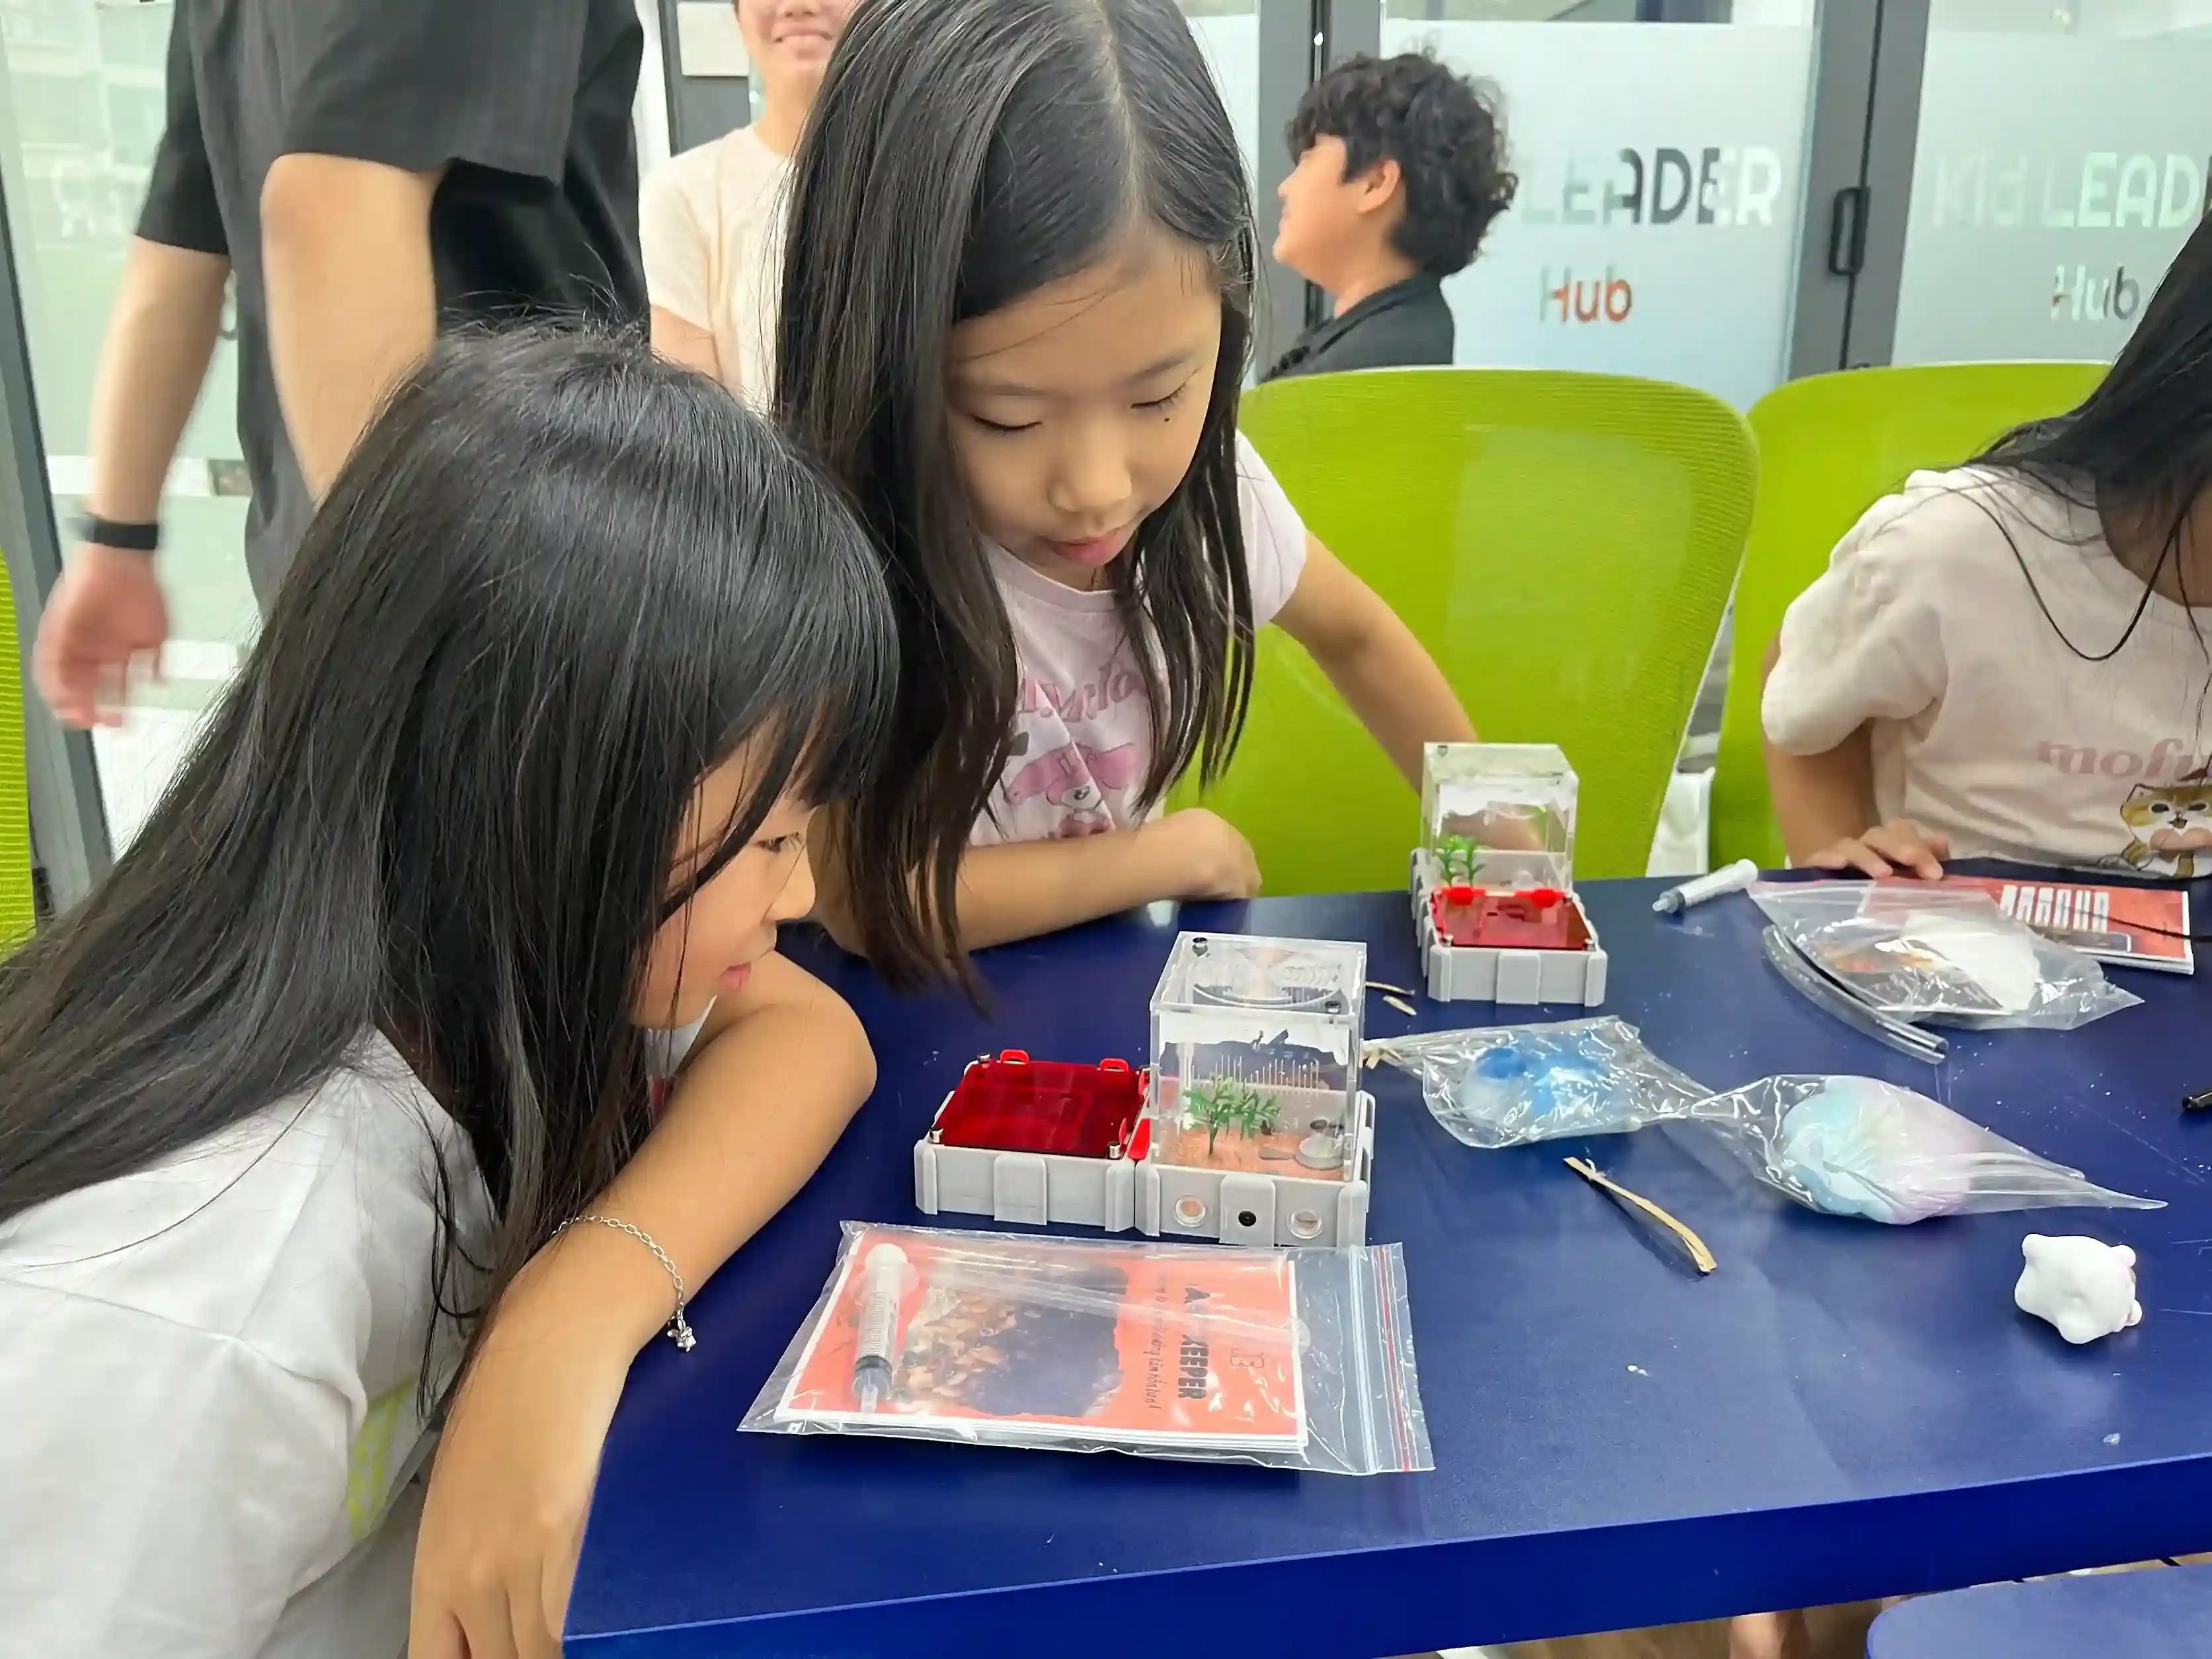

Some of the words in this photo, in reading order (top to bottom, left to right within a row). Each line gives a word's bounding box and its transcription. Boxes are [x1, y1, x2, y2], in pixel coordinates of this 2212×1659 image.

[1519, 145, 1781, 225] LEADER
[2039, 149, 2212, 228] LEAD
[1540, 263, 1633, 323] Hub
[2050, 262, 2141, 321] Hub
